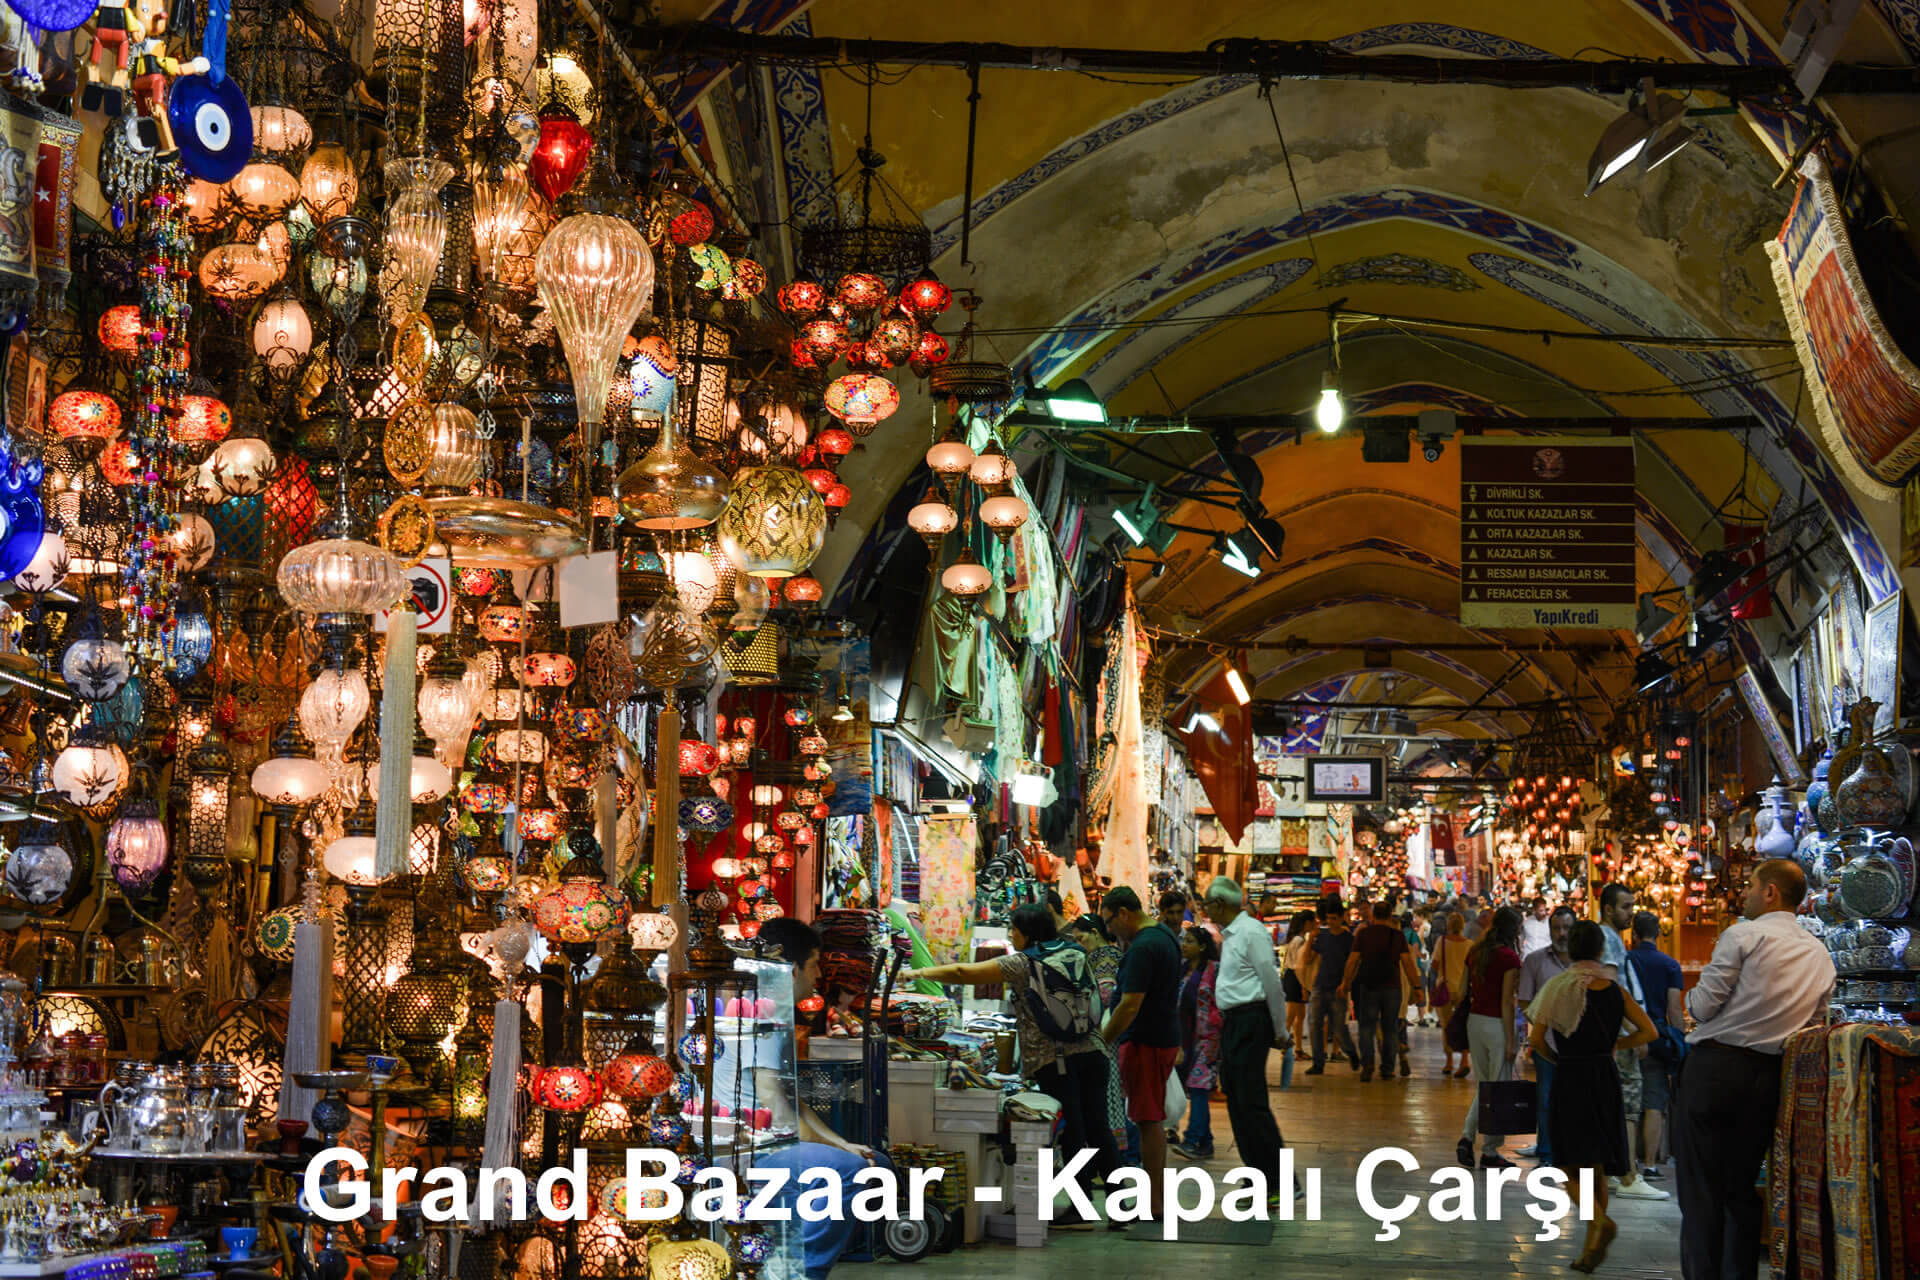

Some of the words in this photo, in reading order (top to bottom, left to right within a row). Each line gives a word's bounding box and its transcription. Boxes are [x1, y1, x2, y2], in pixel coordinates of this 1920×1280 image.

[1486, 486, 1527, 499] DİVRİKLİ
[1528, 488, 1544, 499] SK.
[1486, 508, 1526, 519] KOLTUK
[1527, 508, 1578, 520] KAZAZLAR
[1579, 509, 1597, 520] SK.
[1486, 528, 1513, 539] ORTA
[1515, 528, 1566, 540] KAZAZLAR
[1567, 529, 1584, 540] SK.
[1486, 548, 1538, 559] KAZAZLAR
[1539, 549, 1556, 560] SK.
[1486, 568, 1527, 579] RESSAM
[1528, 568, 1591, 580] BASMACILAR
[1593, 569, 1609, 580] SK.
[1486, 586, 1553, 600] FERACECİLER
[1554, 588, 1571, 600] SK.
[1533, 608, 1599, 626] YapıKredi
